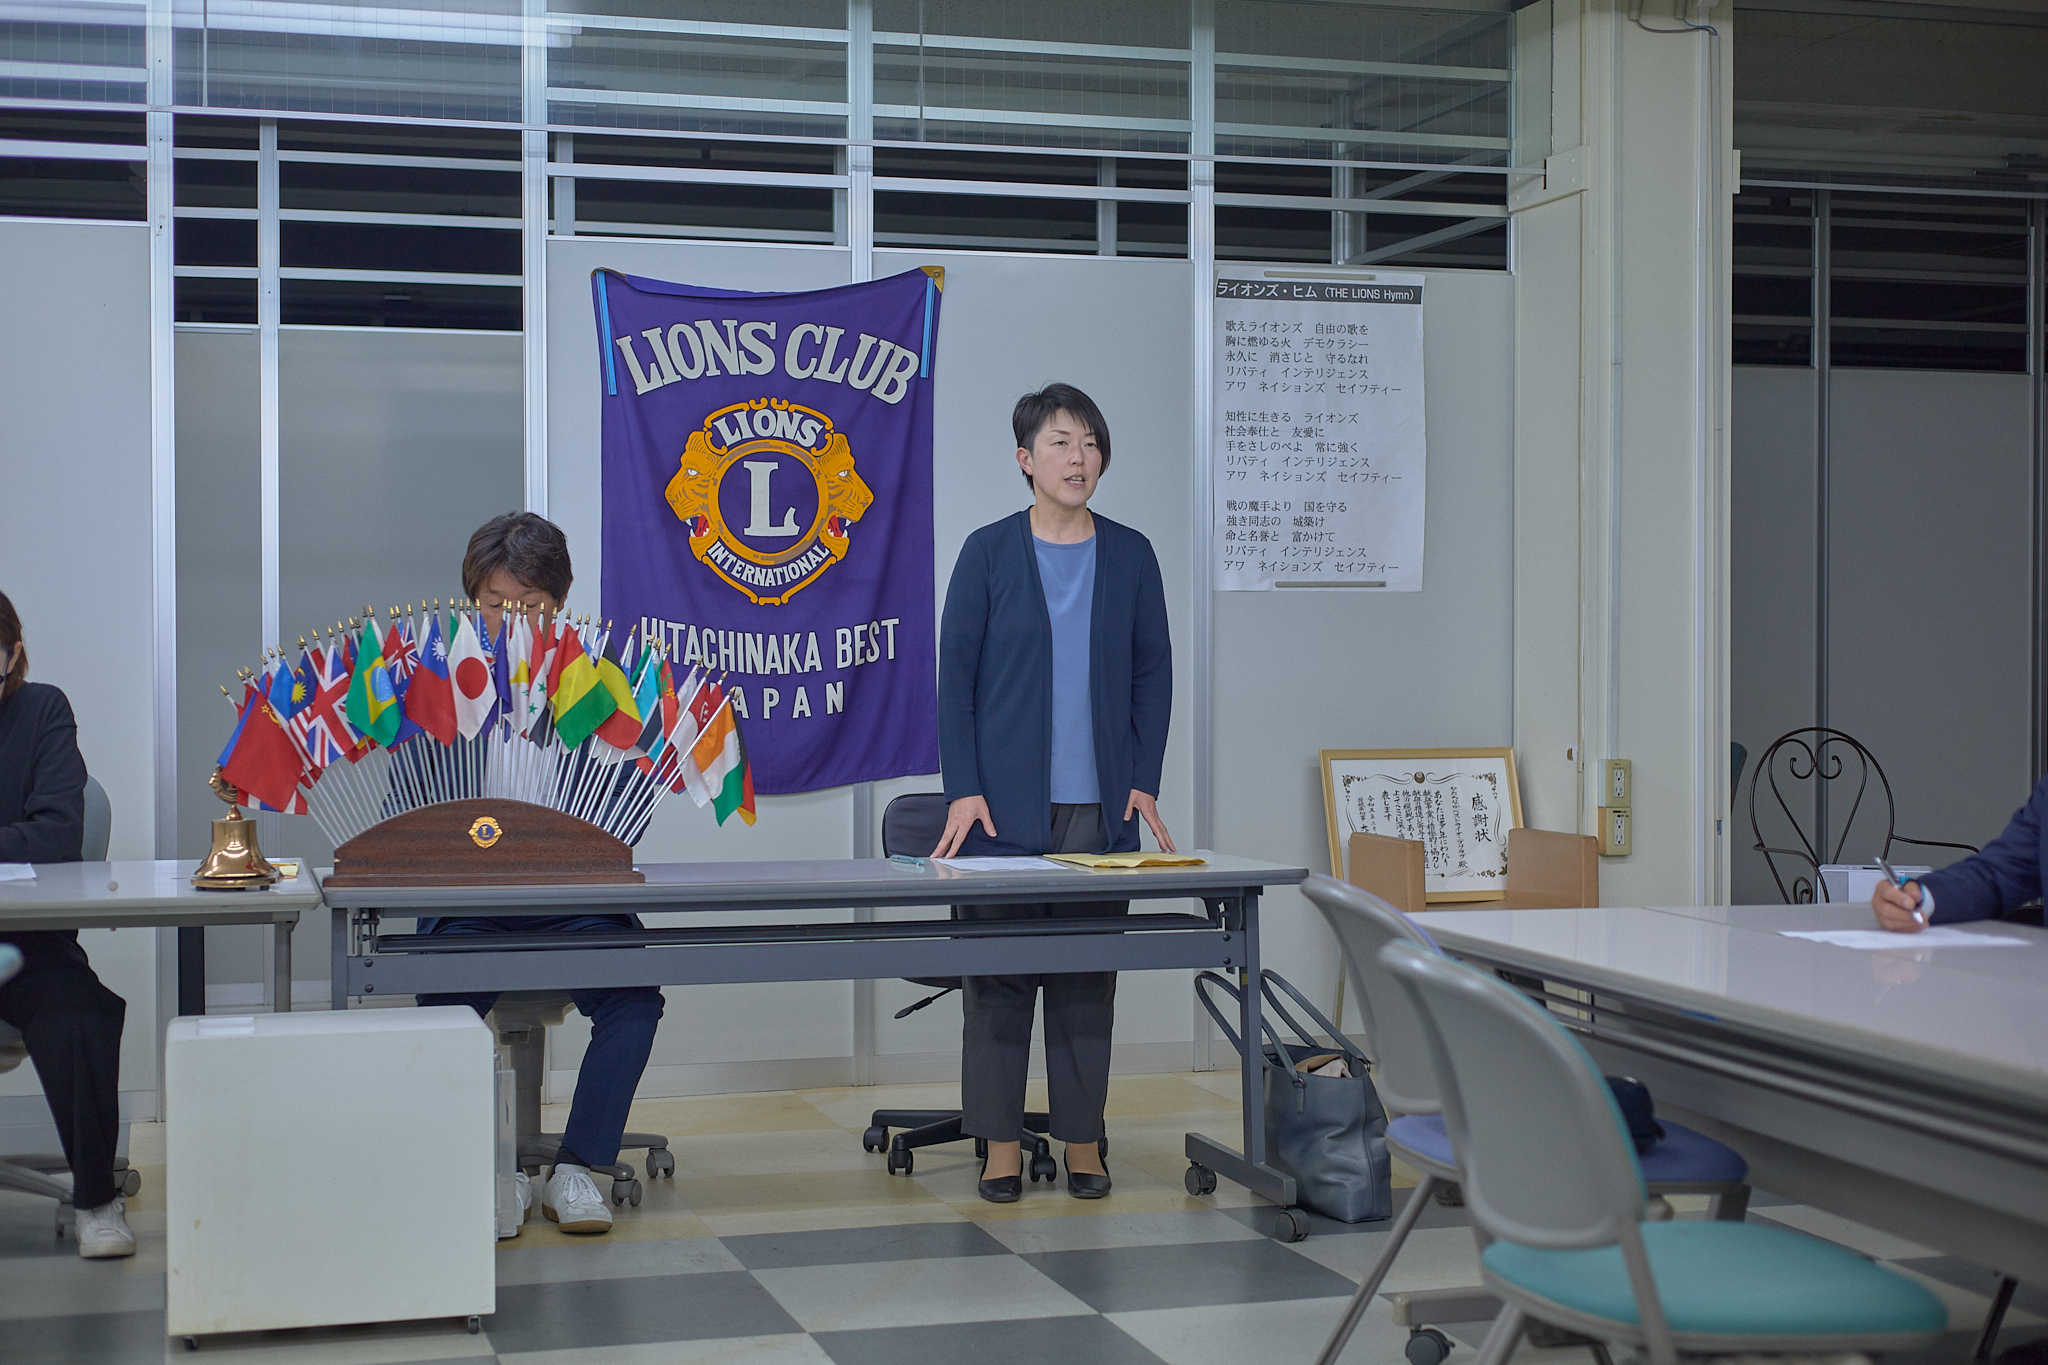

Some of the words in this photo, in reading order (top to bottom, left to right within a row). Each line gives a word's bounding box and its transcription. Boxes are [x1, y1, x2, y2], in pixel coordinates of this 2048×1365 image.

[1217, 282, 1317, 298] ライオンズ・ヒム
[1352, 288, 1381, 299] LIONS
[1226, 320, 1302, 333] 歌えライオンズ
[1316, 323, 1368, 335] 自由の歌を
[1226, 335, 1291, 348] 胸に燃ゆる火
[1303, 337, 1368, 349] デモクラシー
[615, 319, 777, 396] LIONS
[784, 322, 920, 405] CLUB
[1225, 350, 1257, 362] 永久に
[1270, 352, 1313, 363] 消さじと
[1326, 353, 1368, 364] 守るなれ
[1281, 368, 1368, 379] インテリジェンス
[1226, 381, 1246, 391] アワ
[1259, 381, 1325, 393] ネイションズ
[1337, 383, 1401, 395] セイフティー
[1225, 411, 1290, 422] 知性に生きる
[1305, 413, 1358, 423] ライオンズ
[713, 408, 824, 447] LIONS
[1225, 425, 1279, 437] 社会奉仕と
[1292, 427, 1324, 438] 友愛に
[1226, 440, 1302, 452] 手をさしのべよ
[1315, 442, 1357, 453] 常に強く
[1282, 457, 1369, 467] インテリジェンス
[1226, 471, 1246, 481] アワ
[1260, 471, 1326, 482] ネイションズ
[1338, 472, 1401, 483] セイフティー
[743, 460, 800, 537] L
[1227, 500, 1291, 512] 戦の魔手より
[1304, 501, 1346, 513] 国を守る
[1227, 515, 1281, 527] 強き同志の
[1226, 530, 1279, 542] 命と名誉と
[1281, 546, 1366, 557] インテリジェンス
[706, 540, 831, 587] INTERNATIONAL
[1224, 561, 1244, 571] アワ
[1258, 561, 1323, 572] ネイションズ
[1334, 562, 1398, 573] セイフティー
[641, 616, 823, 675] HITACHINAKA
[835, 618, 900, 669] BEST
[709, 681, 844, 720] APAN
[1381, 789, 1392, 822] 表します
[1472, 792, 1492, 842] 感謝状
[481, 825, 490, 838] L
[1434, 789, 1450, 867] あなたは多年にわたり
